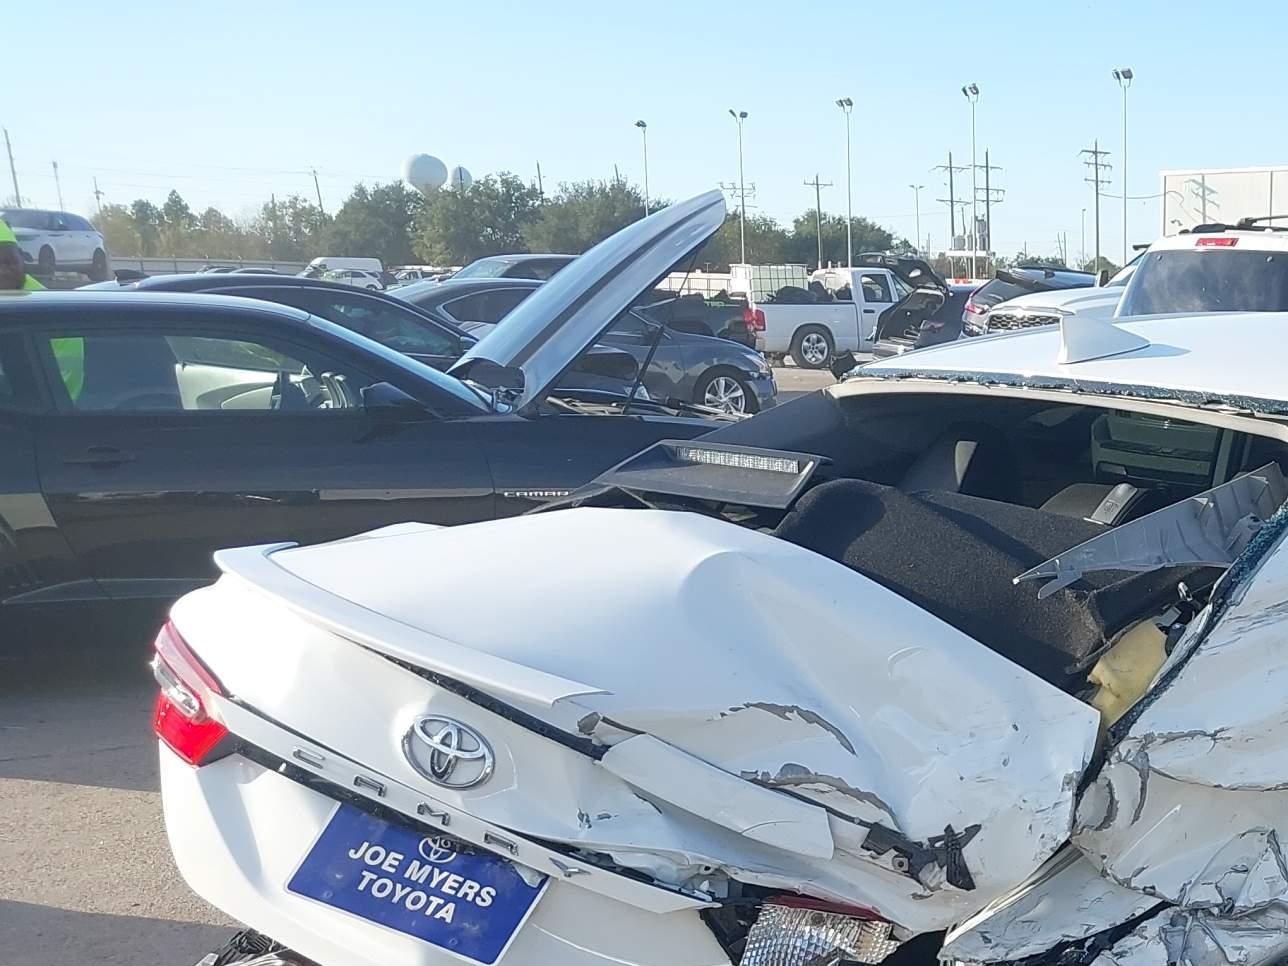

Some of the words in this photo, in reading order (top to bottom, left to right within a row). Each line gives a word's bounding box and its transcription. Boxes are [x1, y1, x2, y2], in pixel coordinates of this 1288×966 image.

[503, 486, 570, 498] CAMAR
[348, 841, 405, 873] JOE
[403, 860, 497, 907] MYERS
[357, 870, 457, 924] TOYOTA
